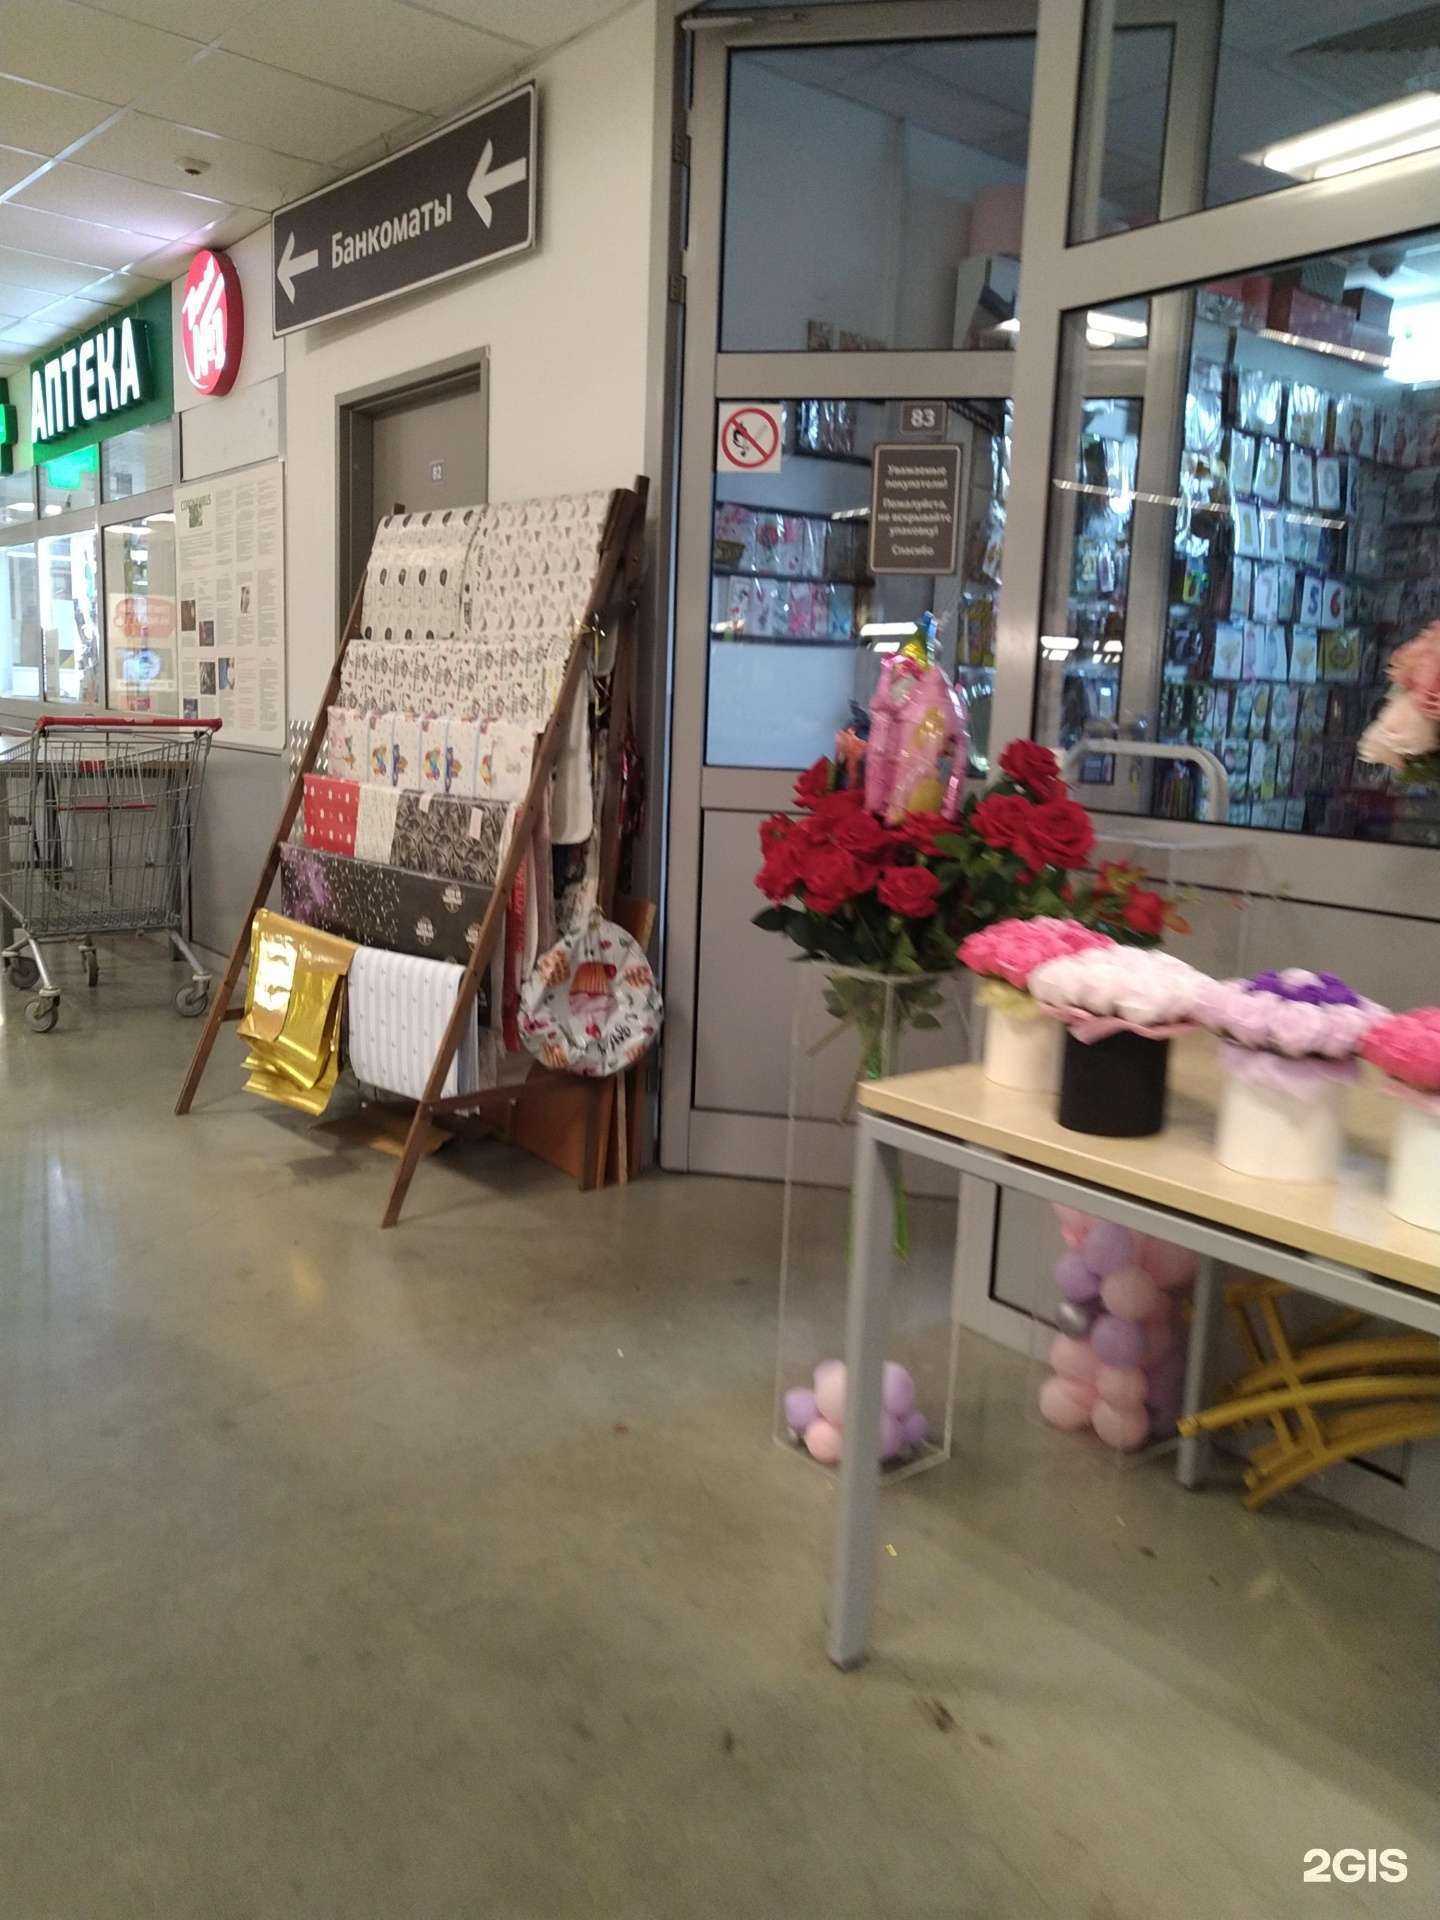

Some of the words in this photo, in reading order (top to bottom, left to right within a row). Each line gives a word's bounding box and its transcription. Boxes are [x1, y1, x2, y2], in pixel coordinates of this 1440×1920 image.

[331, 193, 452, 269] Банкоматы
[31, 316, 141, 444] АПТЕКА
[910, 408, 935, 428] 83
